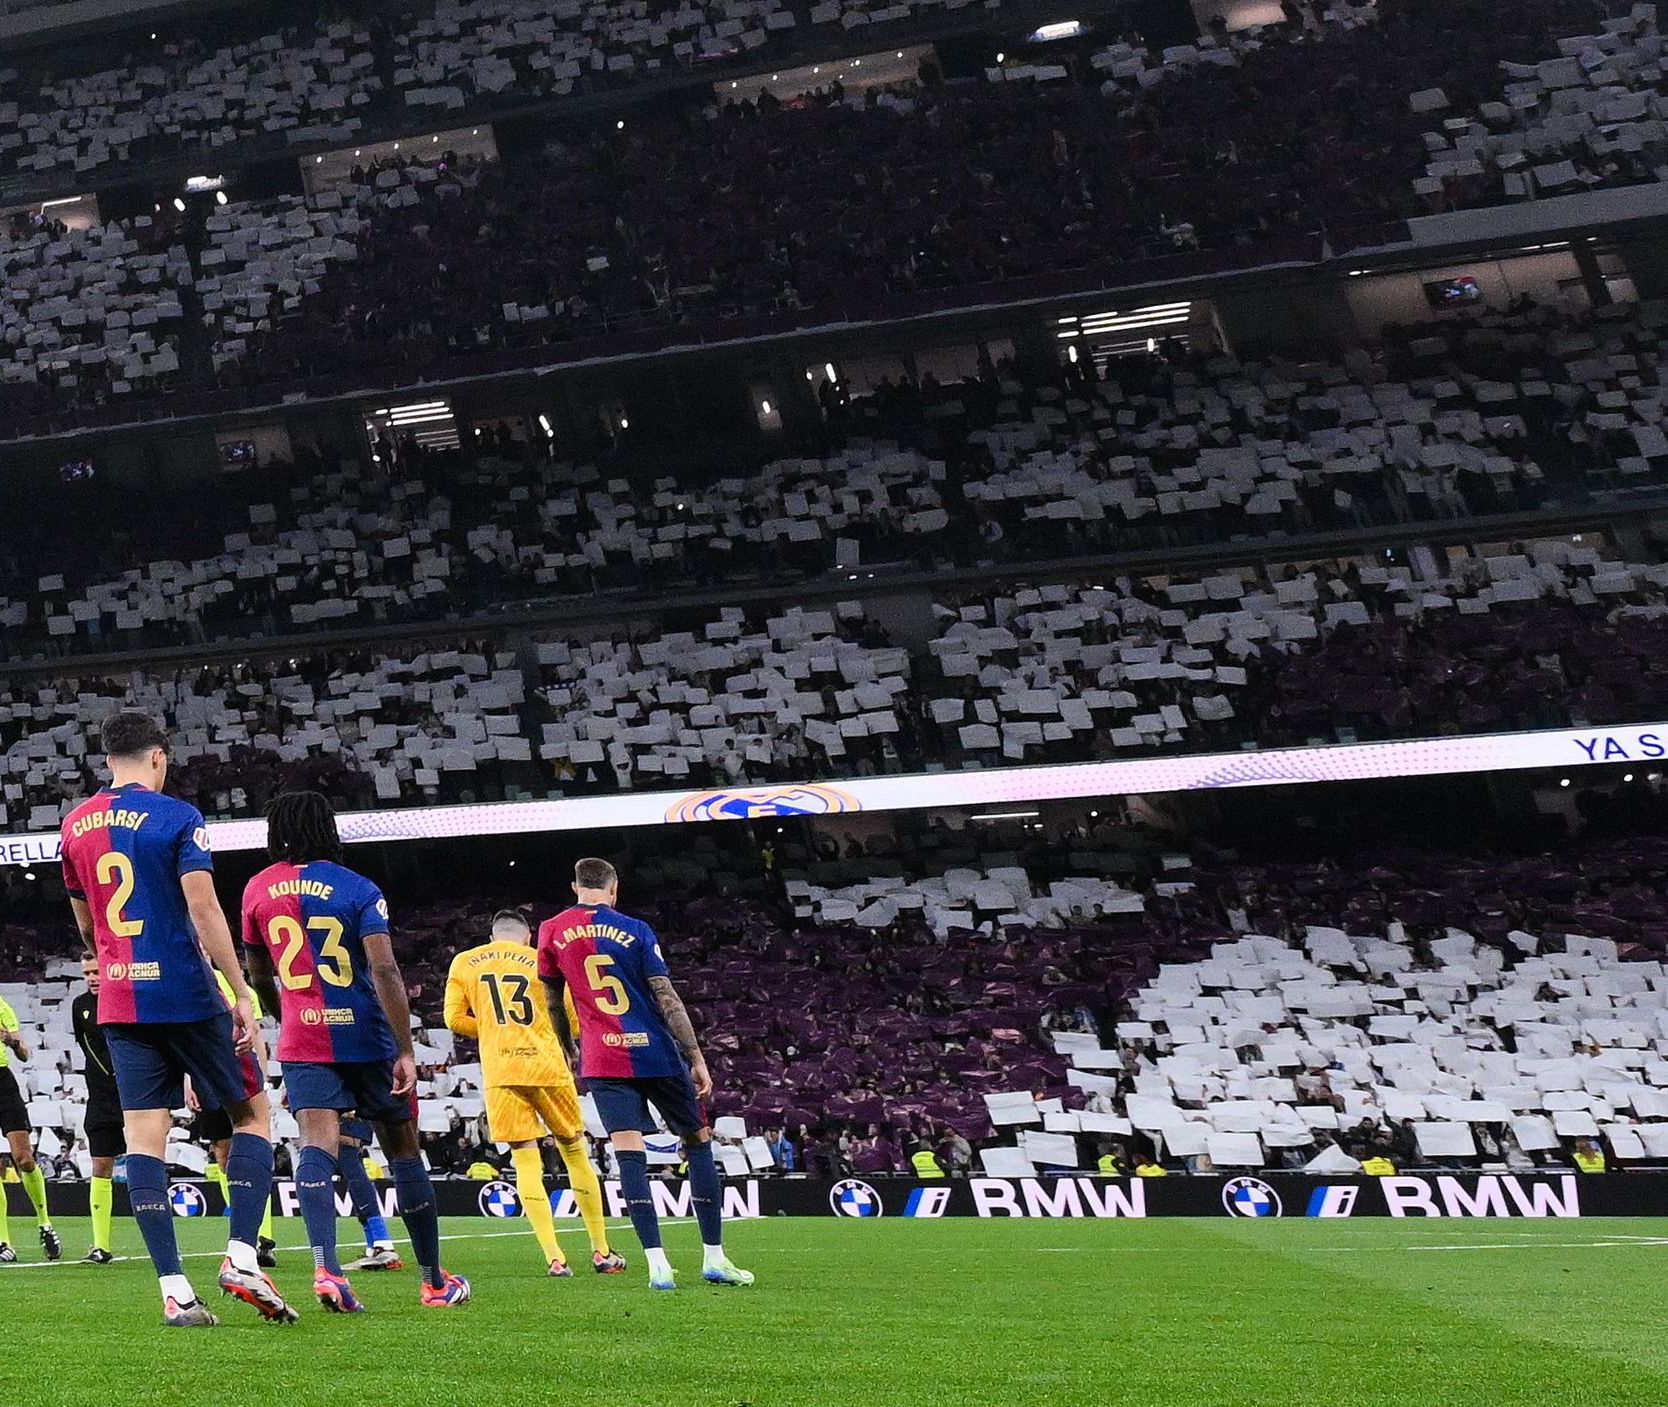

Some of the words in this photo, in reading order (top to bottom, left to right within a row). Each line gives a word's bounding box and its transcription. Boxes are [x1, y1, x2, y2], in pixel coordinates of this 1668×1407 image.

[1572, 736, 1631, 761] YA
[72, 809, 150, 838] CUBARSÍ
[96, 851, 144, 938] 2
[267, 915, 354, 991] 23
[479, 973, 535, 1027] 13
[583, 954, 631, 1016] 5
[969, 1177, 1146, 1218] BMW
[1380, 1175, 1580, 1218] BMW
